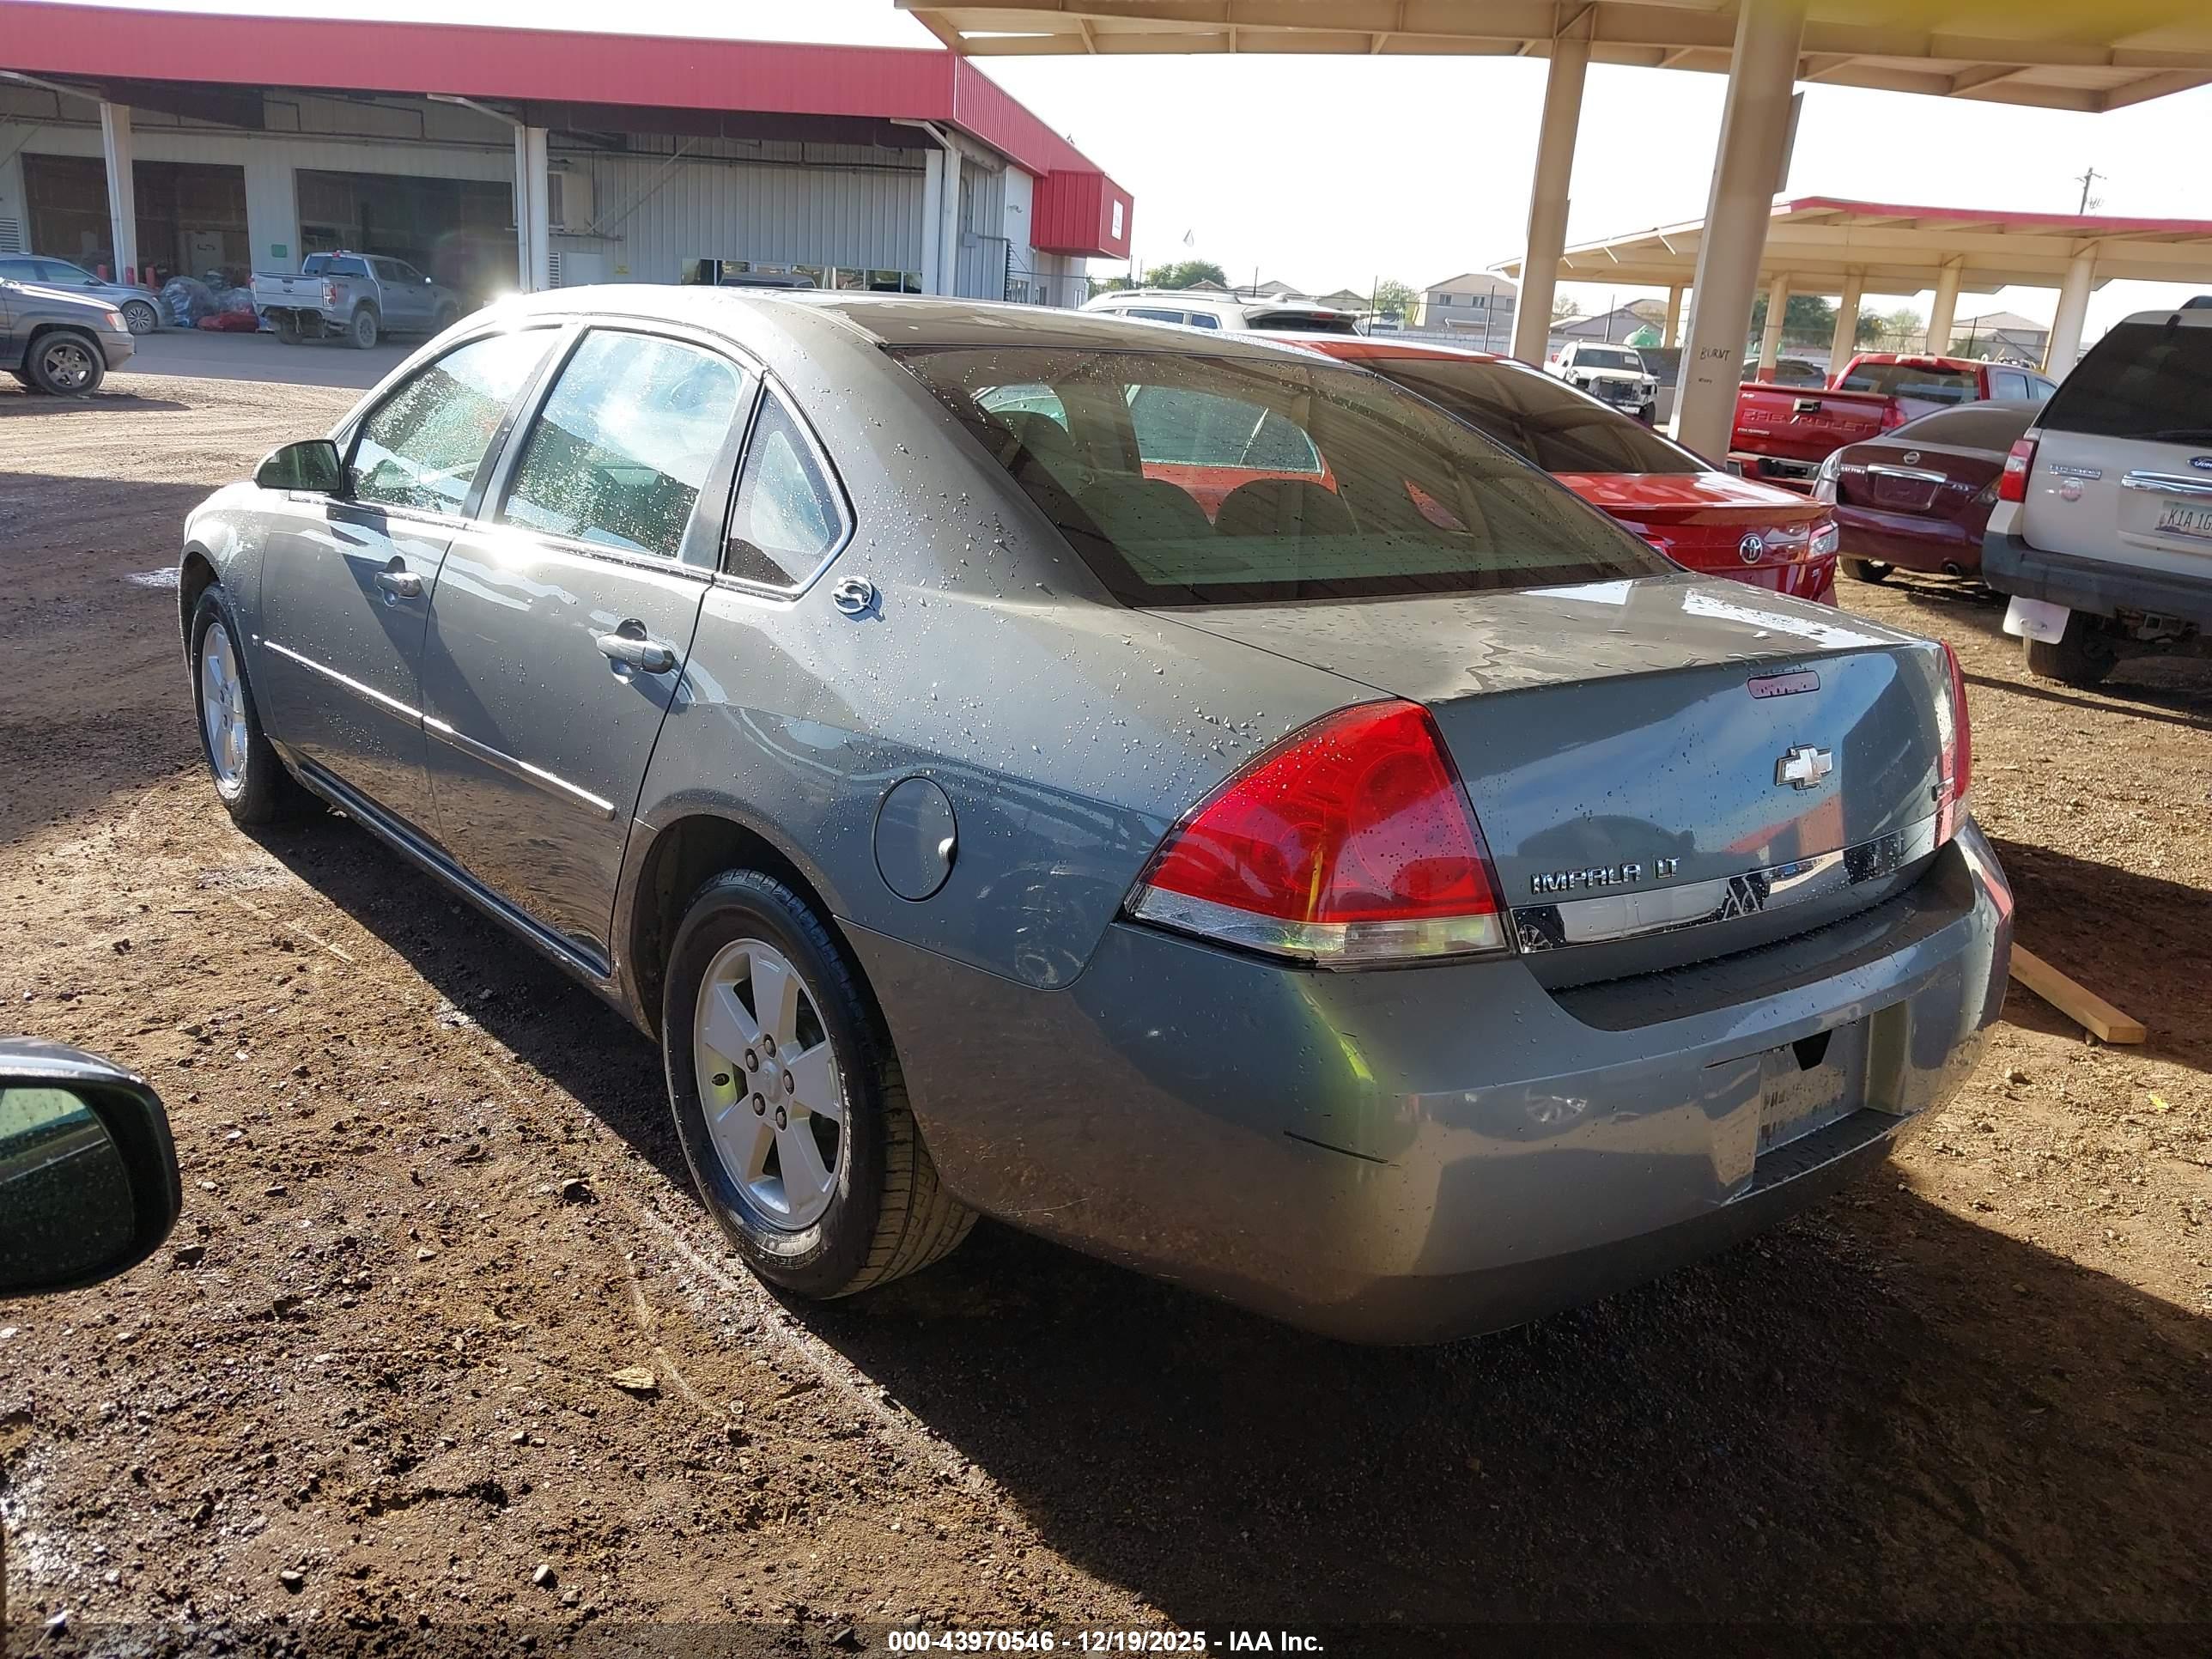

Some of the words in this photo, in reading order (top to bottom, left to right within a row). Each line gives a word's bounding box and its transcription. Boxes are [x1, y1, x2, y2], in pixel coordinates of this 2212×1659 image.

[1699, 347, 1731, 362] BURNT
[1531, 863, 1641, 894] IMPALA
[1654, 857, 1680, 878] LT
